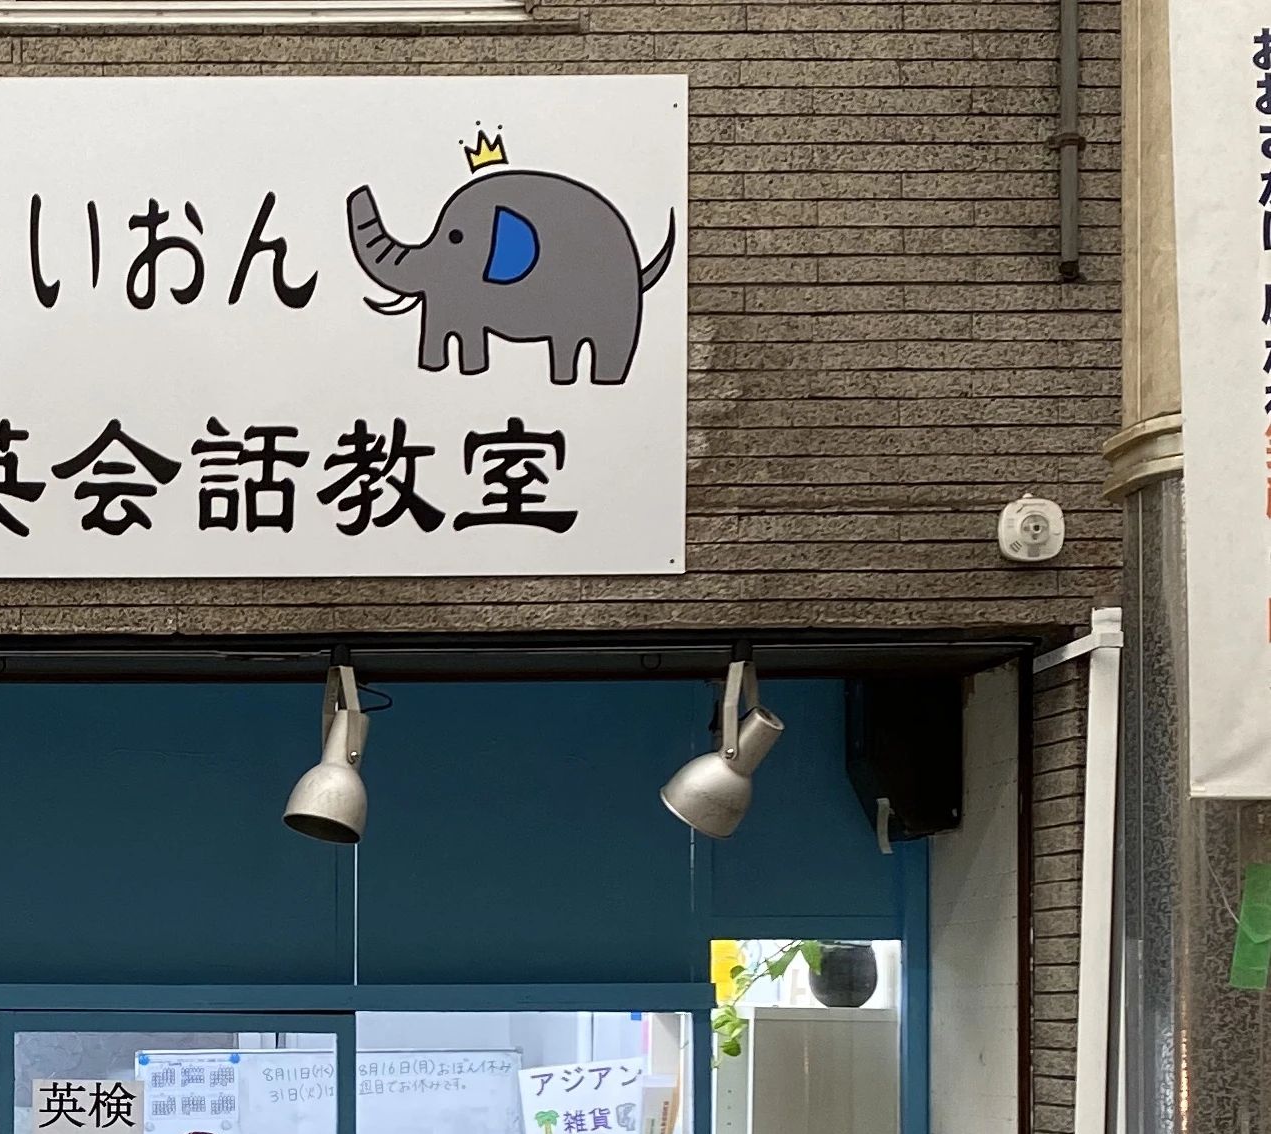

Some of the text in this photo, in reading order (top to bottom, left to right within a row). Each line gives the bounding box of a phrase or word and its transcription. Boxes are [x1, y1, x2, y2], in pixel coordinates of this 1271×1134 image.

[530, 1065, 643, 1096] アジアン
[38, 1082, 136, 1129] 英検
[563, 1107, 613, 1134] 雑貨
